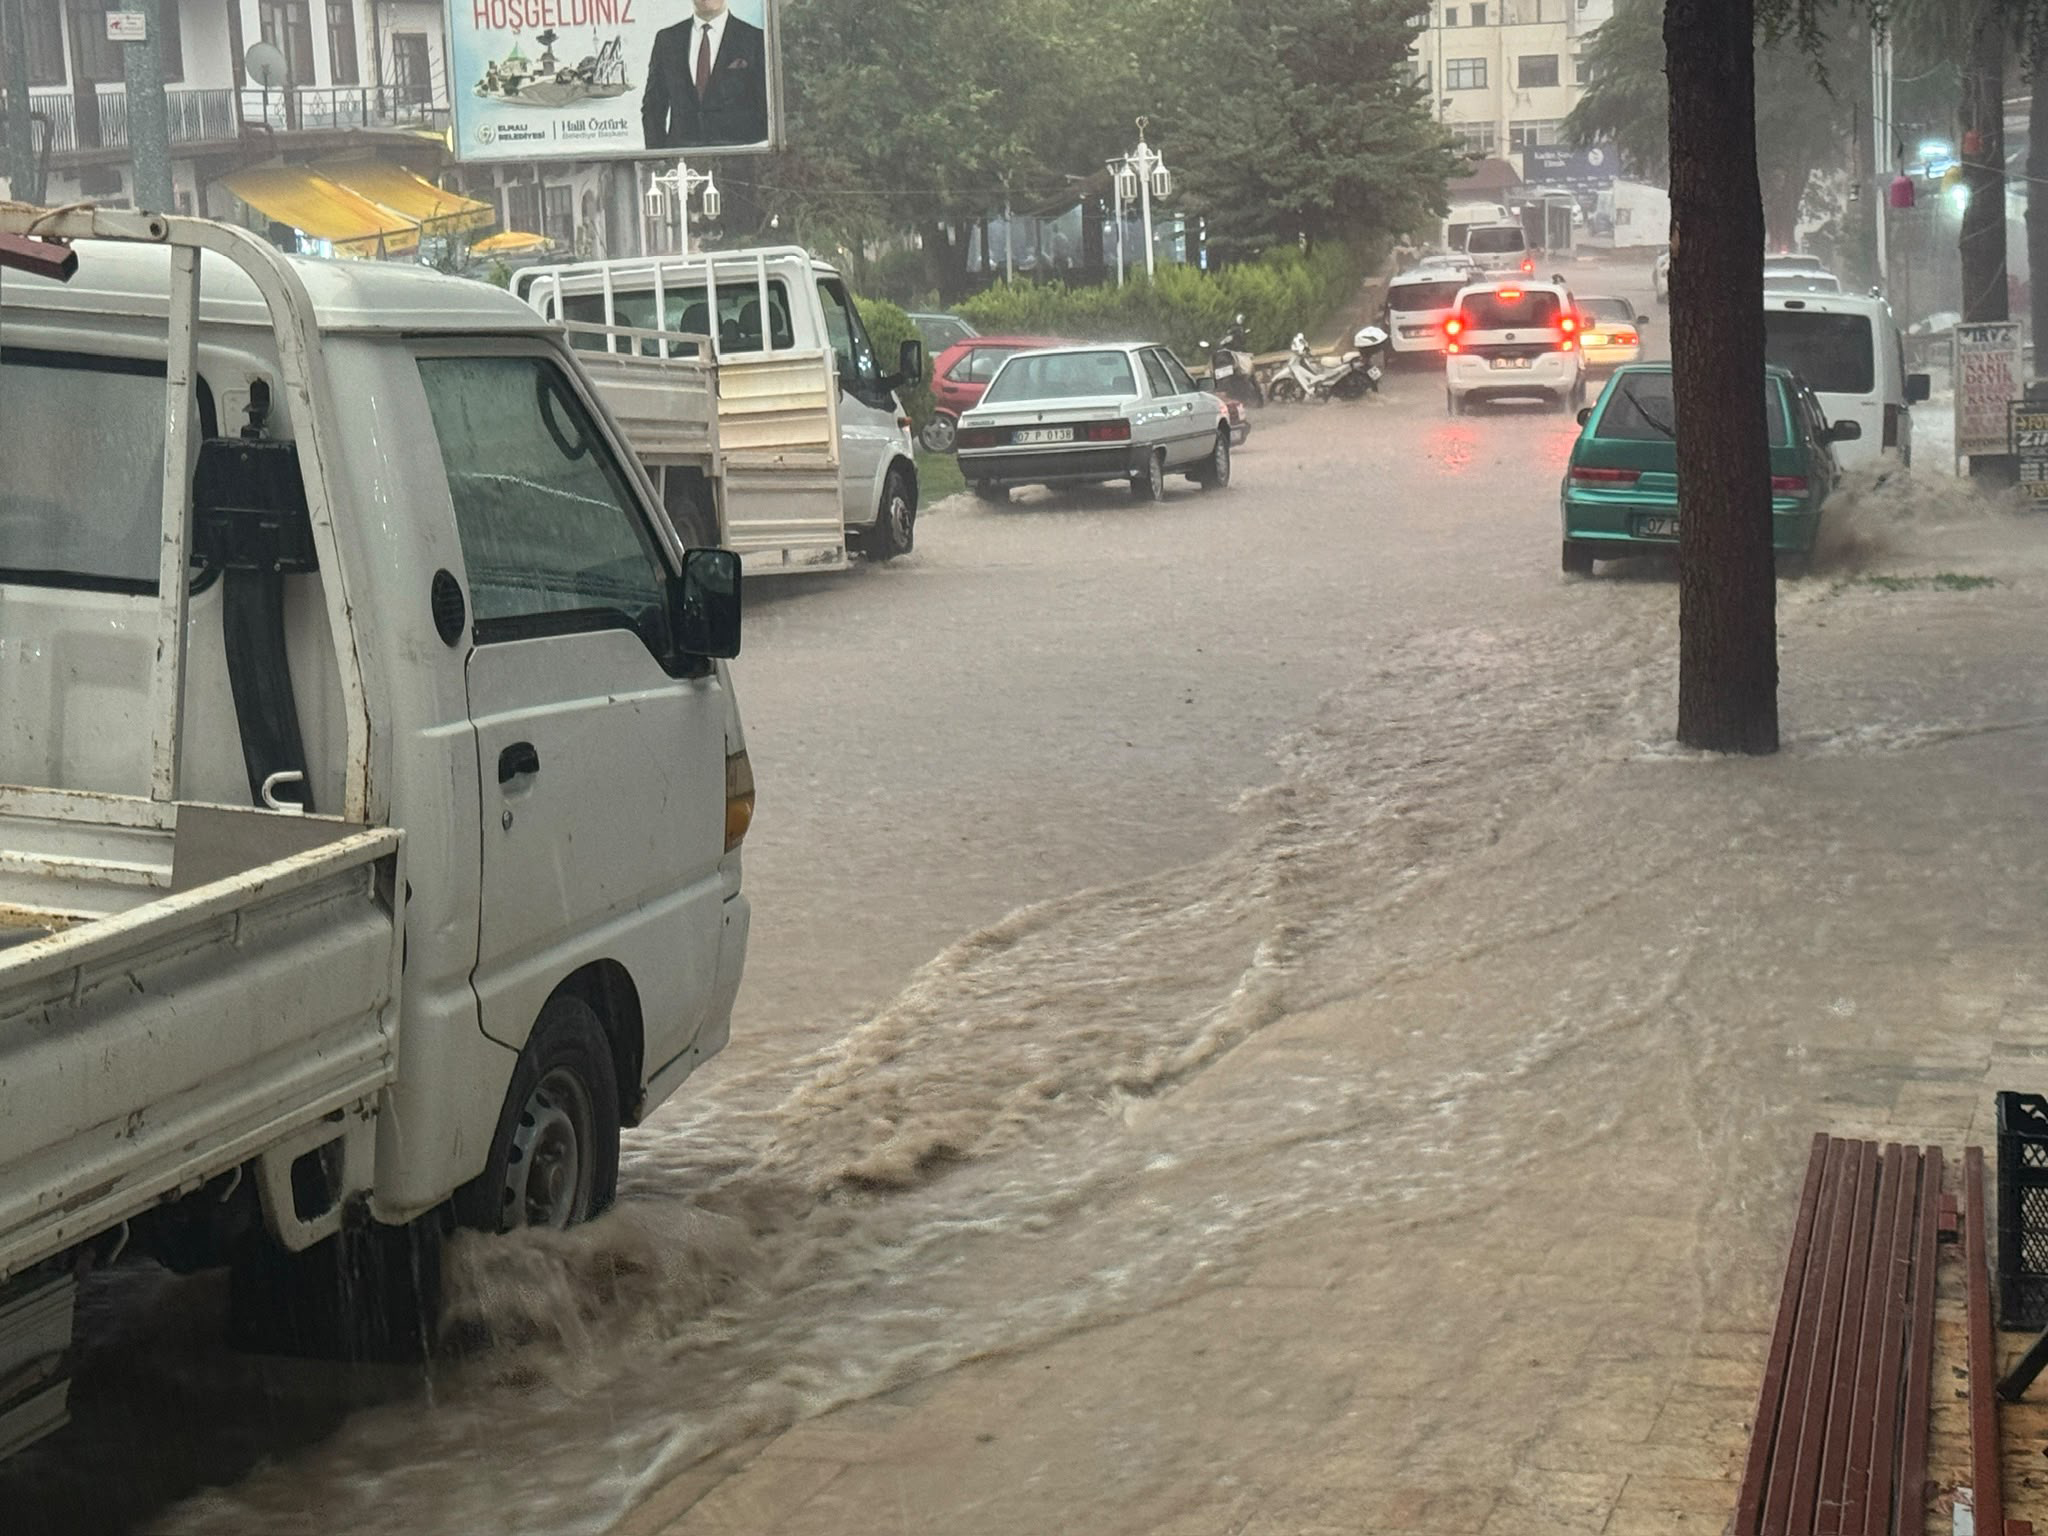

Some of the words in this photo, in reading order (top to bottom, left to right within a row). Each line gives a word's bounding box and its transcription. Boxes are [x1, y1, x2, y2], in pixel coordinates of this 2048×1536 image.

[497, 123, 529, 132] ELMALI
[561, 120, 586, 132] Halil
[1017, 432, 1030, 442] 07
[1035, 430, 1041, 440] P
[1647, 518, 1665, 532] 07
